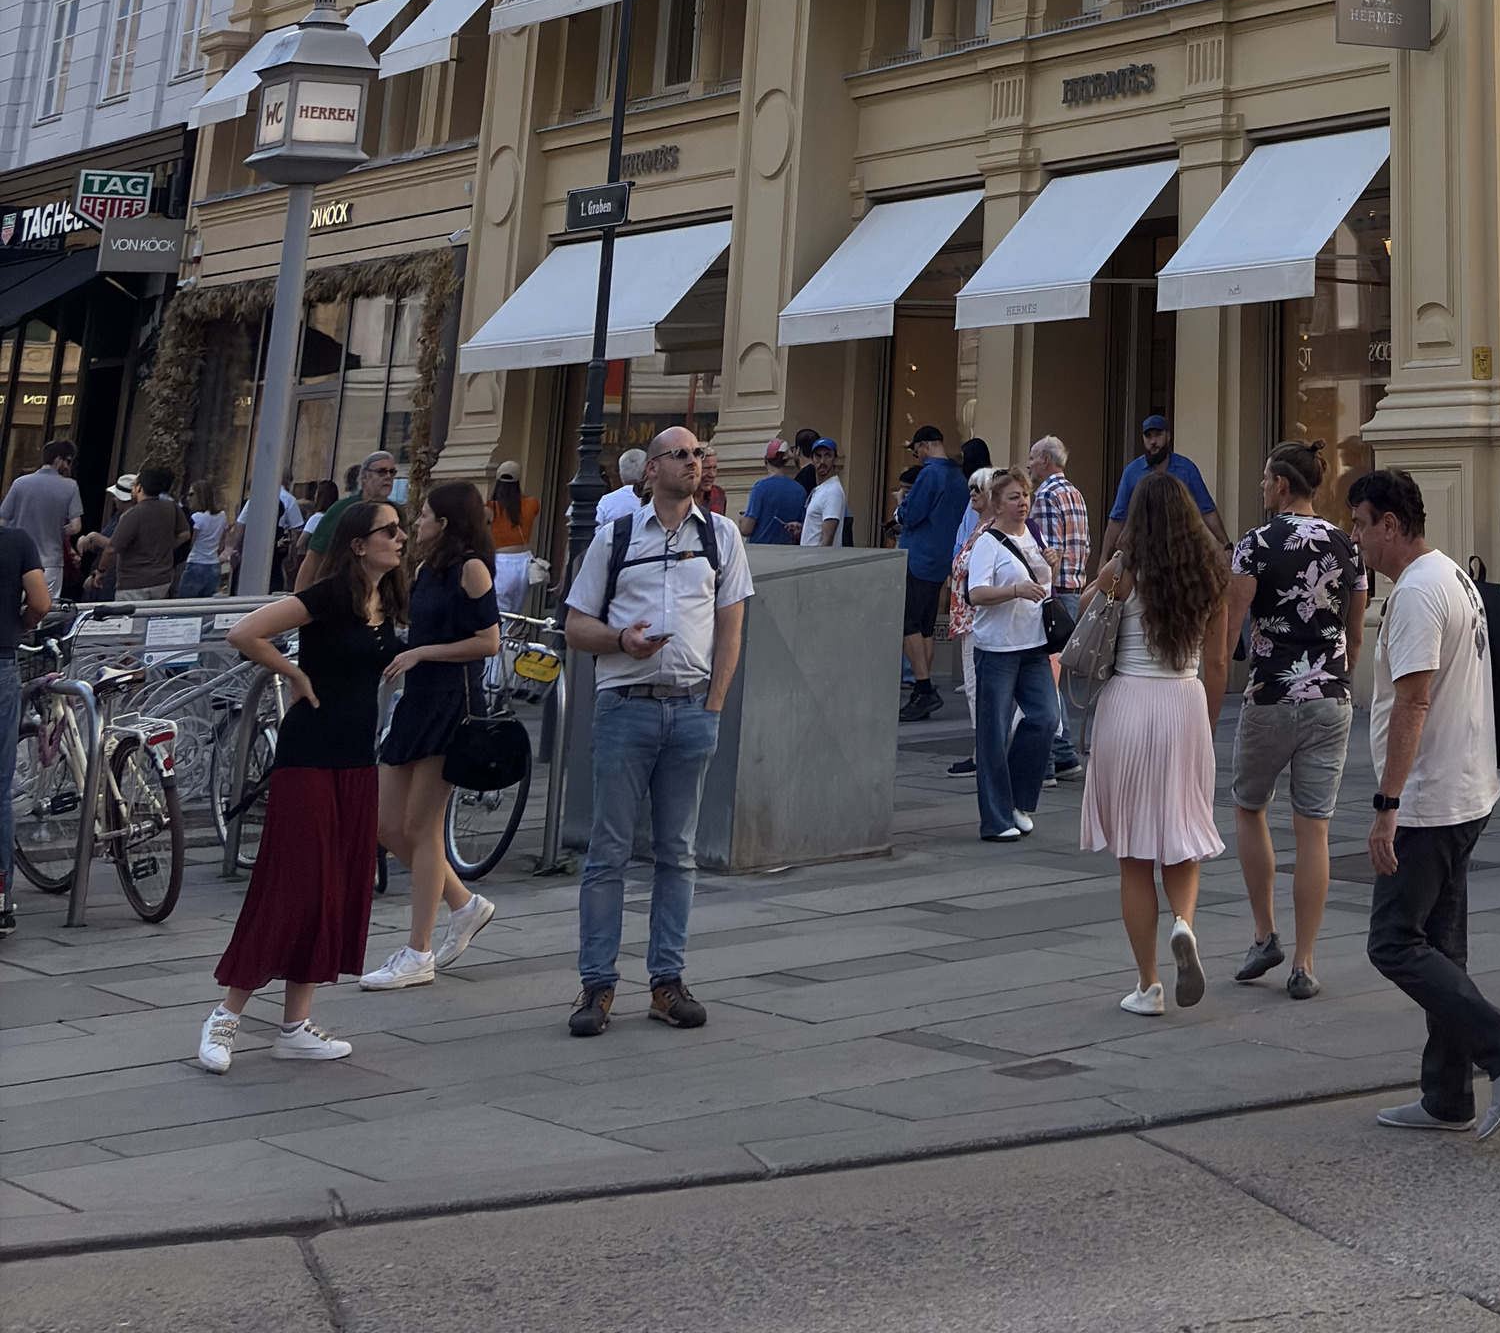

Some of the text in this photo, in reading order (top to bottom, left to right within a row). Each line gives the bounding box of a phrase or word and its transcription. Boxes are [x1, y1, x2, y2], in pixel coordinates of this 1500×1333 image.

[265, 101, 284, 126] WC
[298, 105, 356, 122] HERREN
[87, 175, 145, 195] TAG
[322, 201, 349, 226] KÖCK
[588, 199, 612, 215] Graben
[110, 237, 176, 252] VON KÖCK
